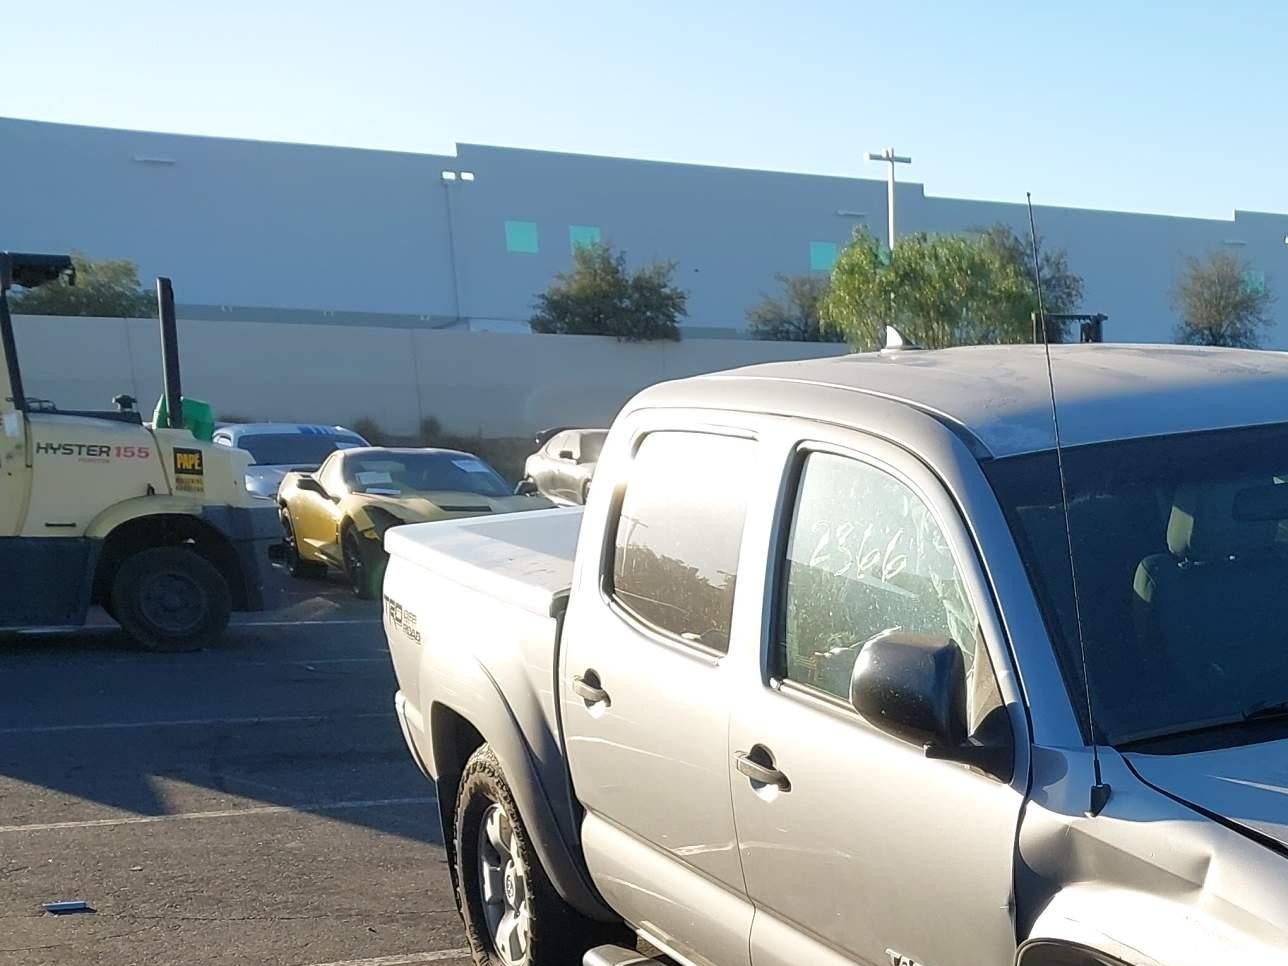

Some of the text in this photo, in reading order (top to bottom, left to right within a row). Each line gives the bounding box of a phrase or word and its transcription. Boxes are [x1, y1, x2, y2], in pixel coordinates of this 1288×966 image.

[36, 442, 150, 460] HYSTER 155
[808, 519, 907, 583] 2366
[383, 593, 403, 629] TRD
